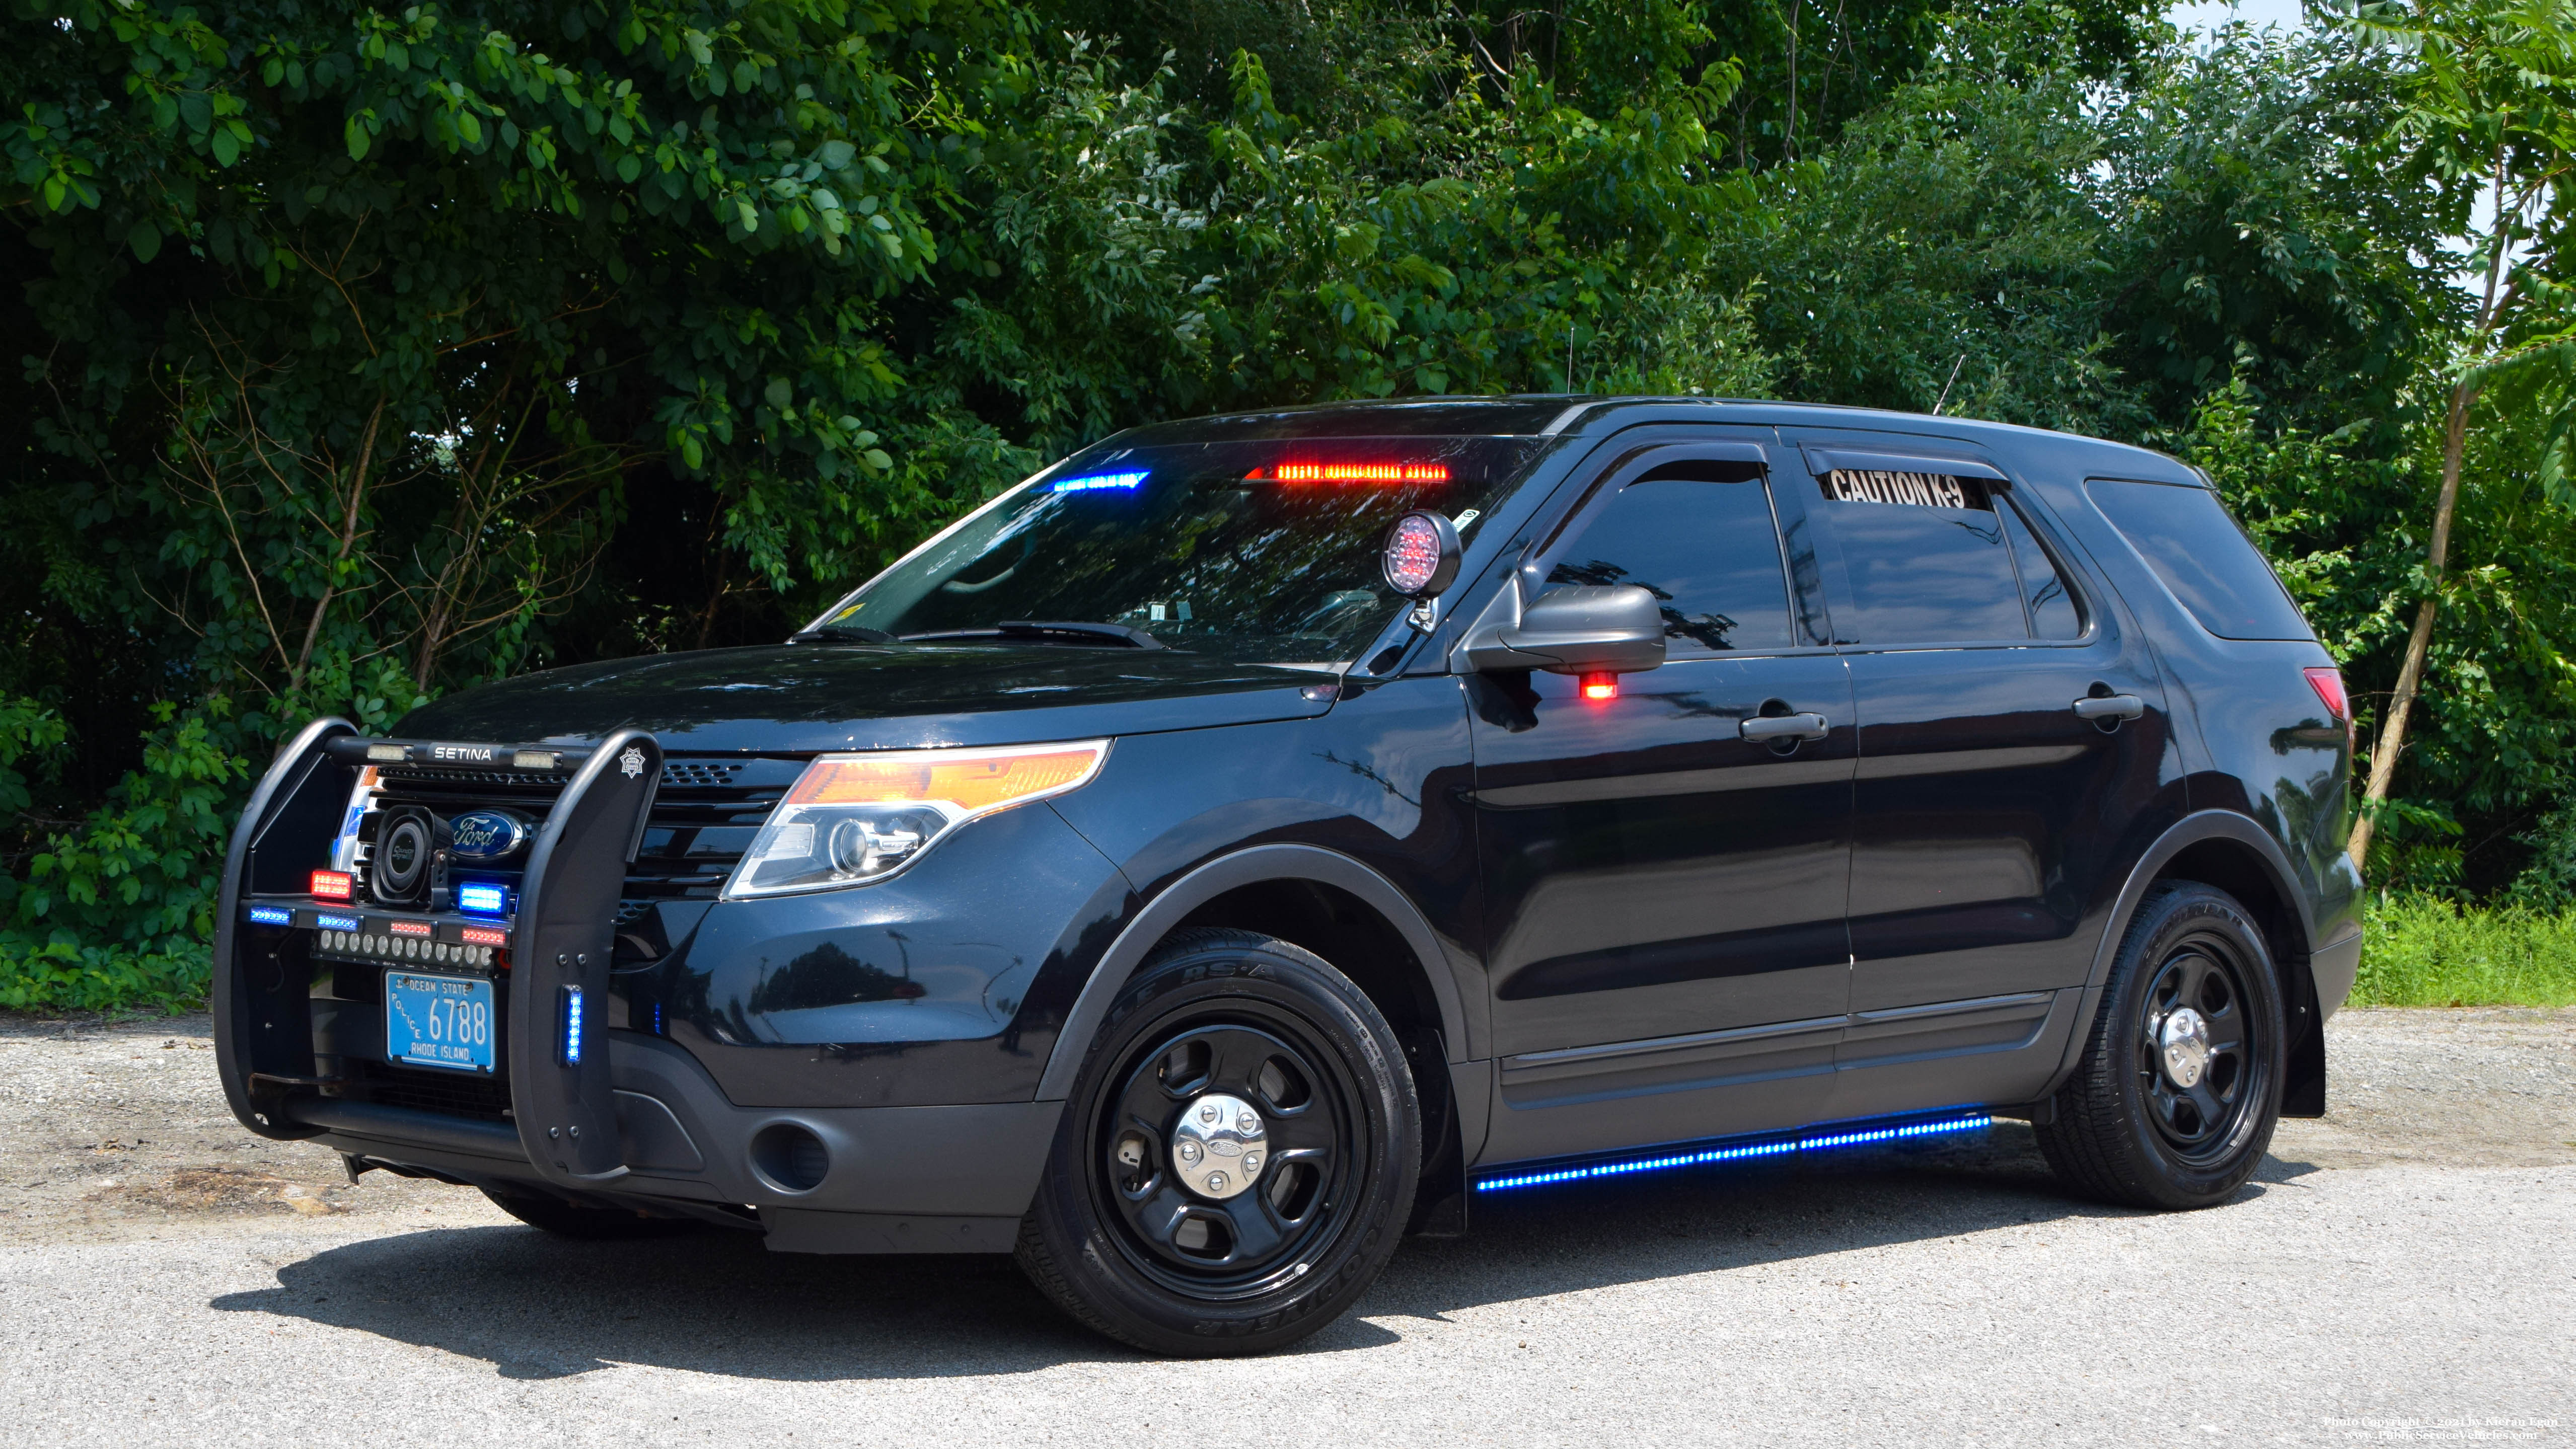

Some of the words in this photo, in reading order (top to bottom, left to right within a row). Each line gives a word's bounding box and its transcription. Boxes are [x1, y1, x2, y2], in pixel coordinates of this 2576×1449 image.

[1830, 469, 1932, 506] CAUTION
[1927, 473, 1965, 509] K-9
[434, 747, 491, 761] SETINA
[454, 817, 498, 846] Ford
[409, 979, 436, 992] OCEAN
[442, 982, 468, 996] STATE
[391, 993, 421, 1039] POLICE
[429, 998, 486, 1045] 6788
[411, 1042, 437, 1057] RHODE
[441, 1045, 469, 1061] ISLAND
[1213, 1142, 1237, 1155] Ford
[1193, 1200, 1391, 1337] GOODYEAR
